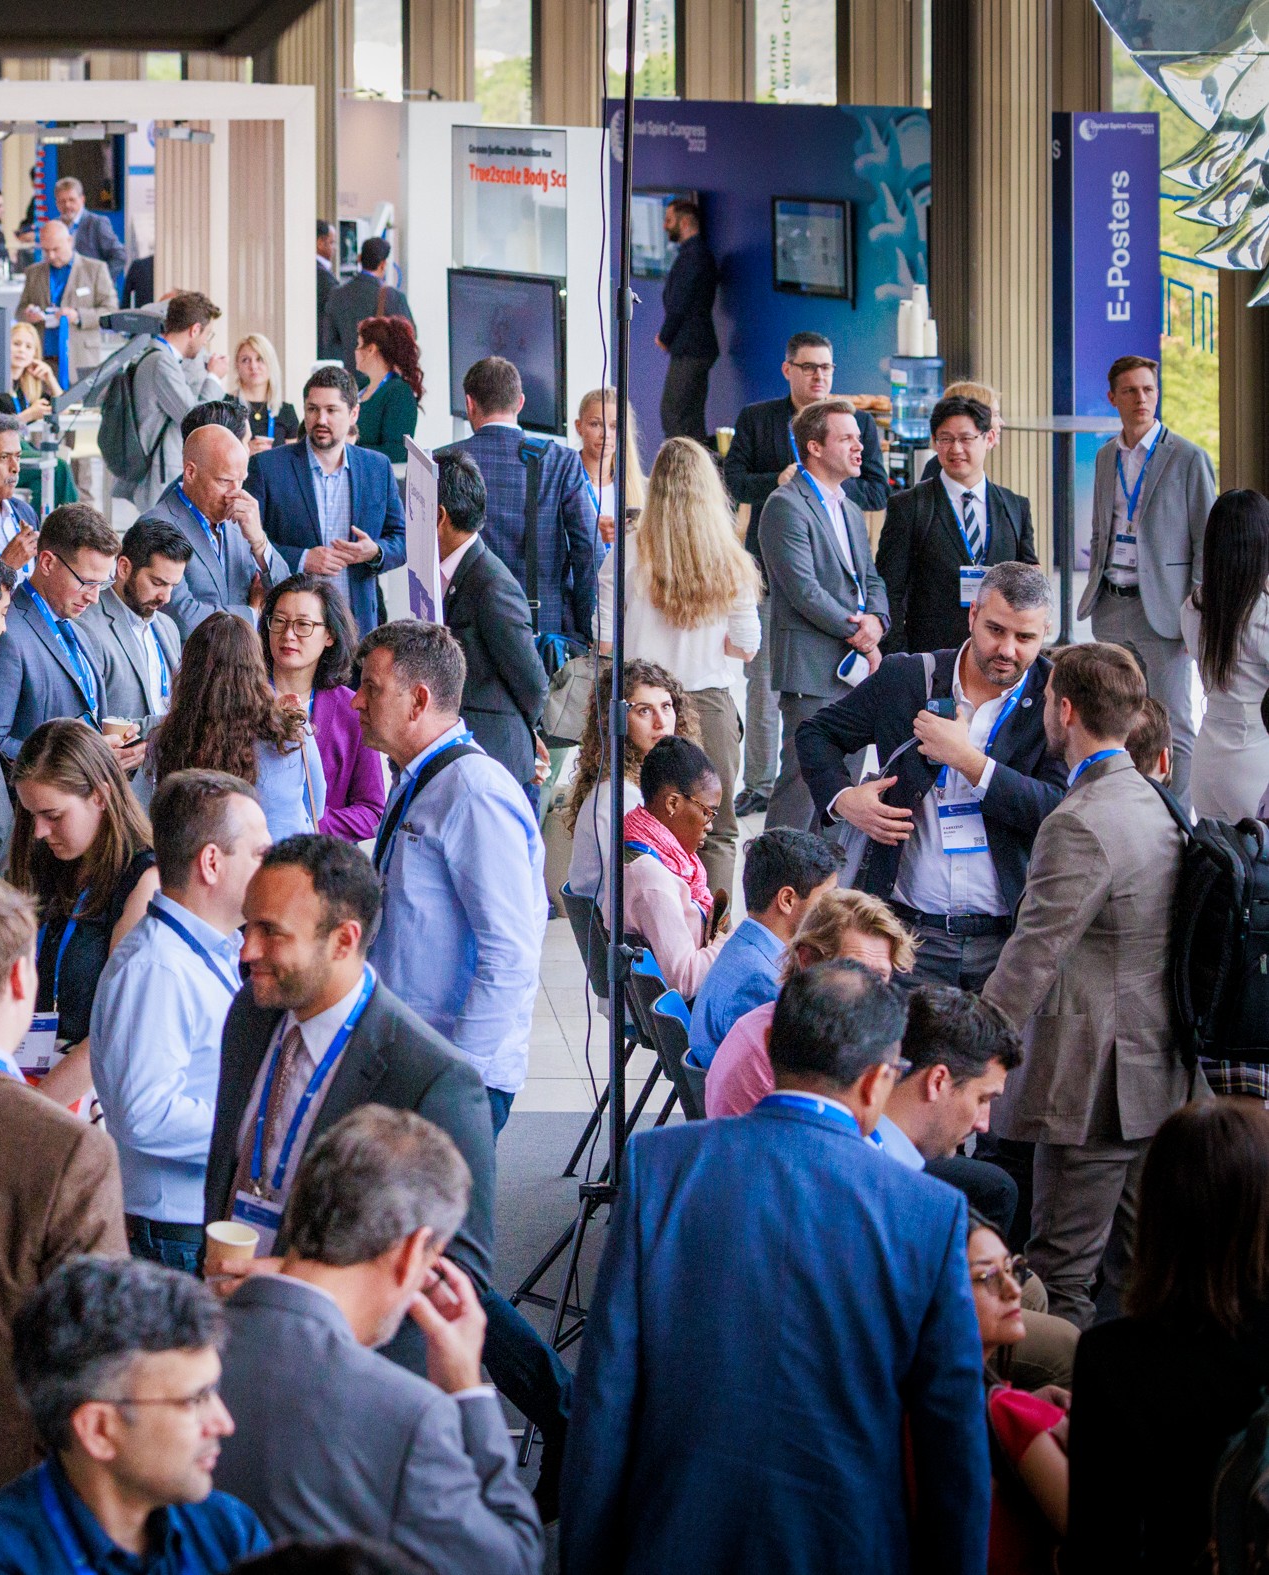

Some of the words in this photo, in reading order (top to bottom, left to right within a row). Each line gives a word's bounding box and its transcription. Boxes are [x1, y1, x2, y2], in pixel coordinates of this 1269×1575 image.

[469, 163, 521, 185] True2scale
[523, 167, 548, 192] Body
[1107, 170, 1131, 322] E-Posters
